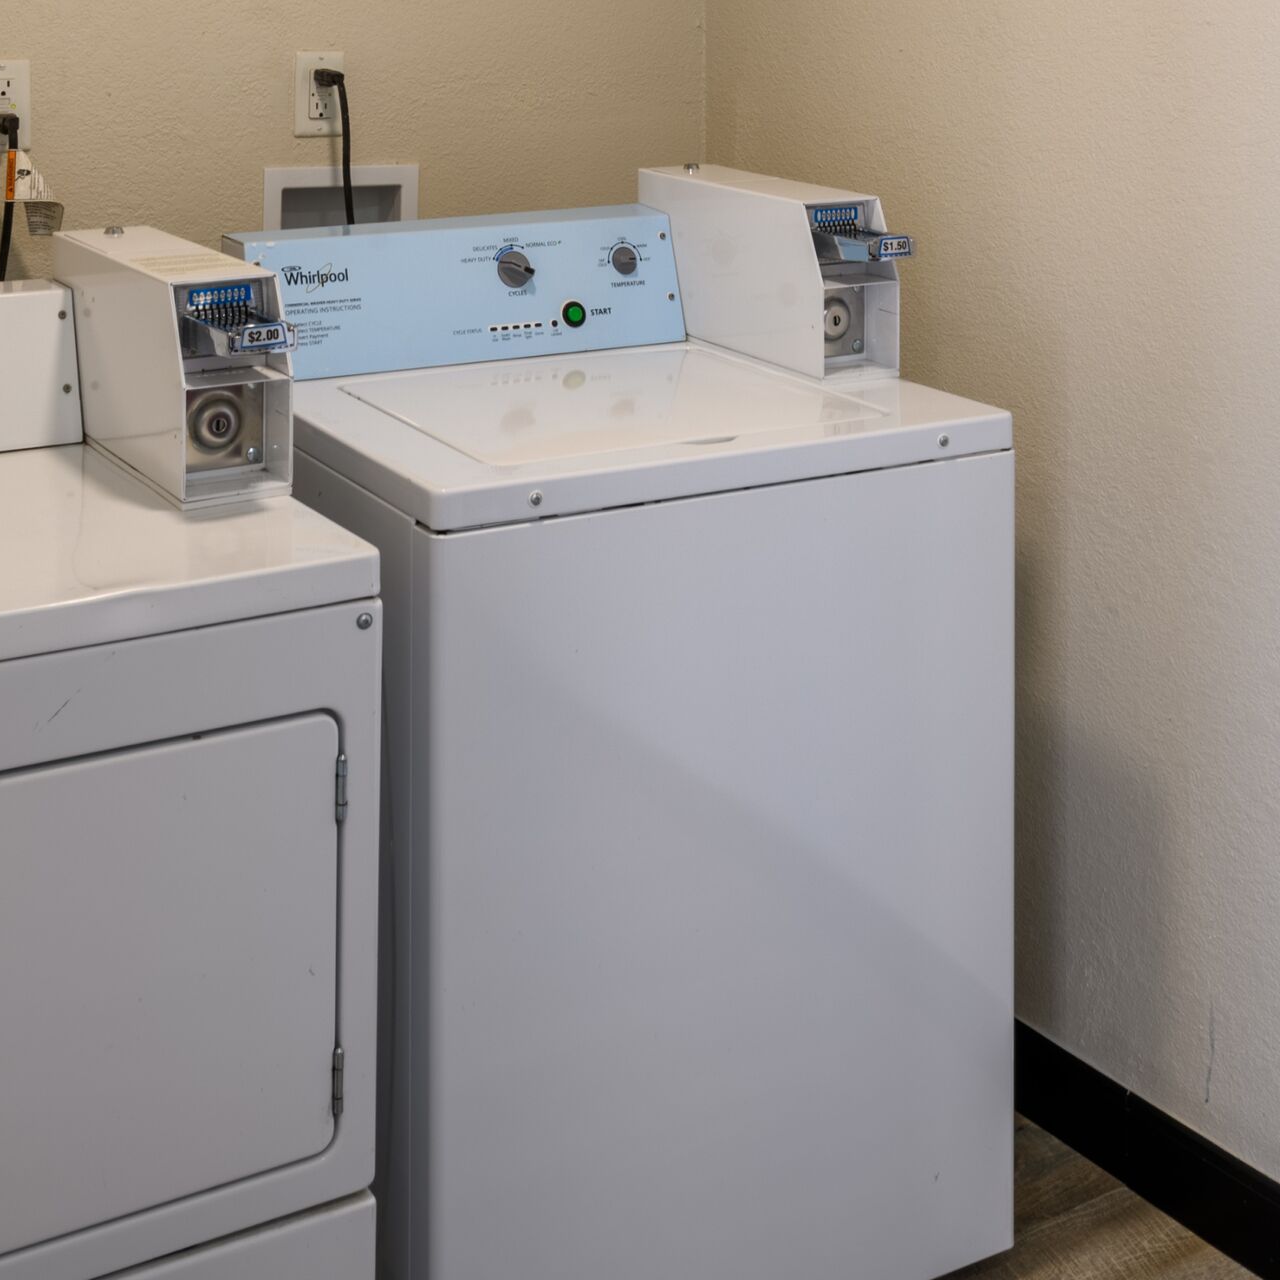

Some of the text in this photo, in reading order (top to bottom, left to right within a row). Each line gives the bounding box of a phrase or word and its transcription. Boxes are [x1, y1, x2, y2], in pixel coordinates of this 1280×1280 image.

[883, 240, 906, 252] $1.50
[284, 268, 348, 288] Whirlpool
[610, 280, 646, 288] TEMPERATURE
[286, 304, 362, 316] OPERATING INSTRUCTIONS
[590, 308, 612, 316] START
[248, 328, 279, 344] $2.00
